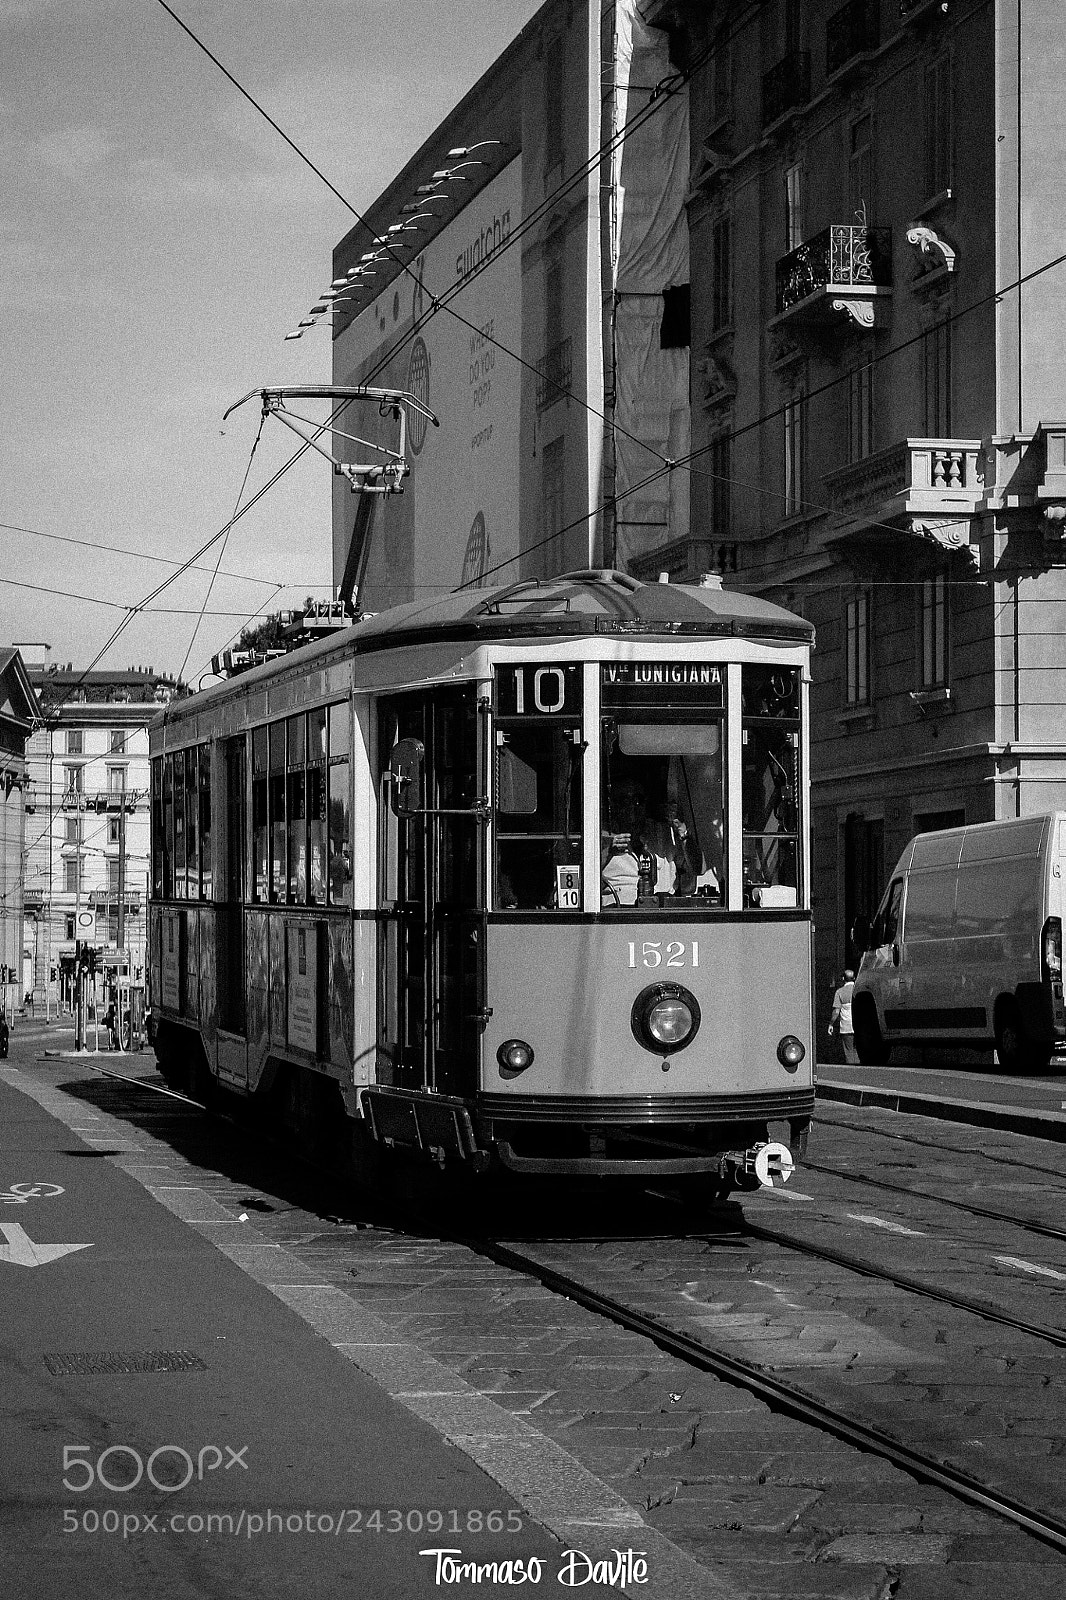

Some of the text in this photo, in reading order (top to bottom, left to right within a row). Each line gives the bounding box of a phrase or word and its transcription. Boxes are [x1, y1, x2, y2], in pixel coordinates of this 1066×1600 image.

[634, 664, 721, 684] LUNIGIANA
[514, 666, 565, 714] 10
[566, 873, 574, 889] 8
[562, 891, 578, 906] 10
[627, 941, 700, 968] 1521
